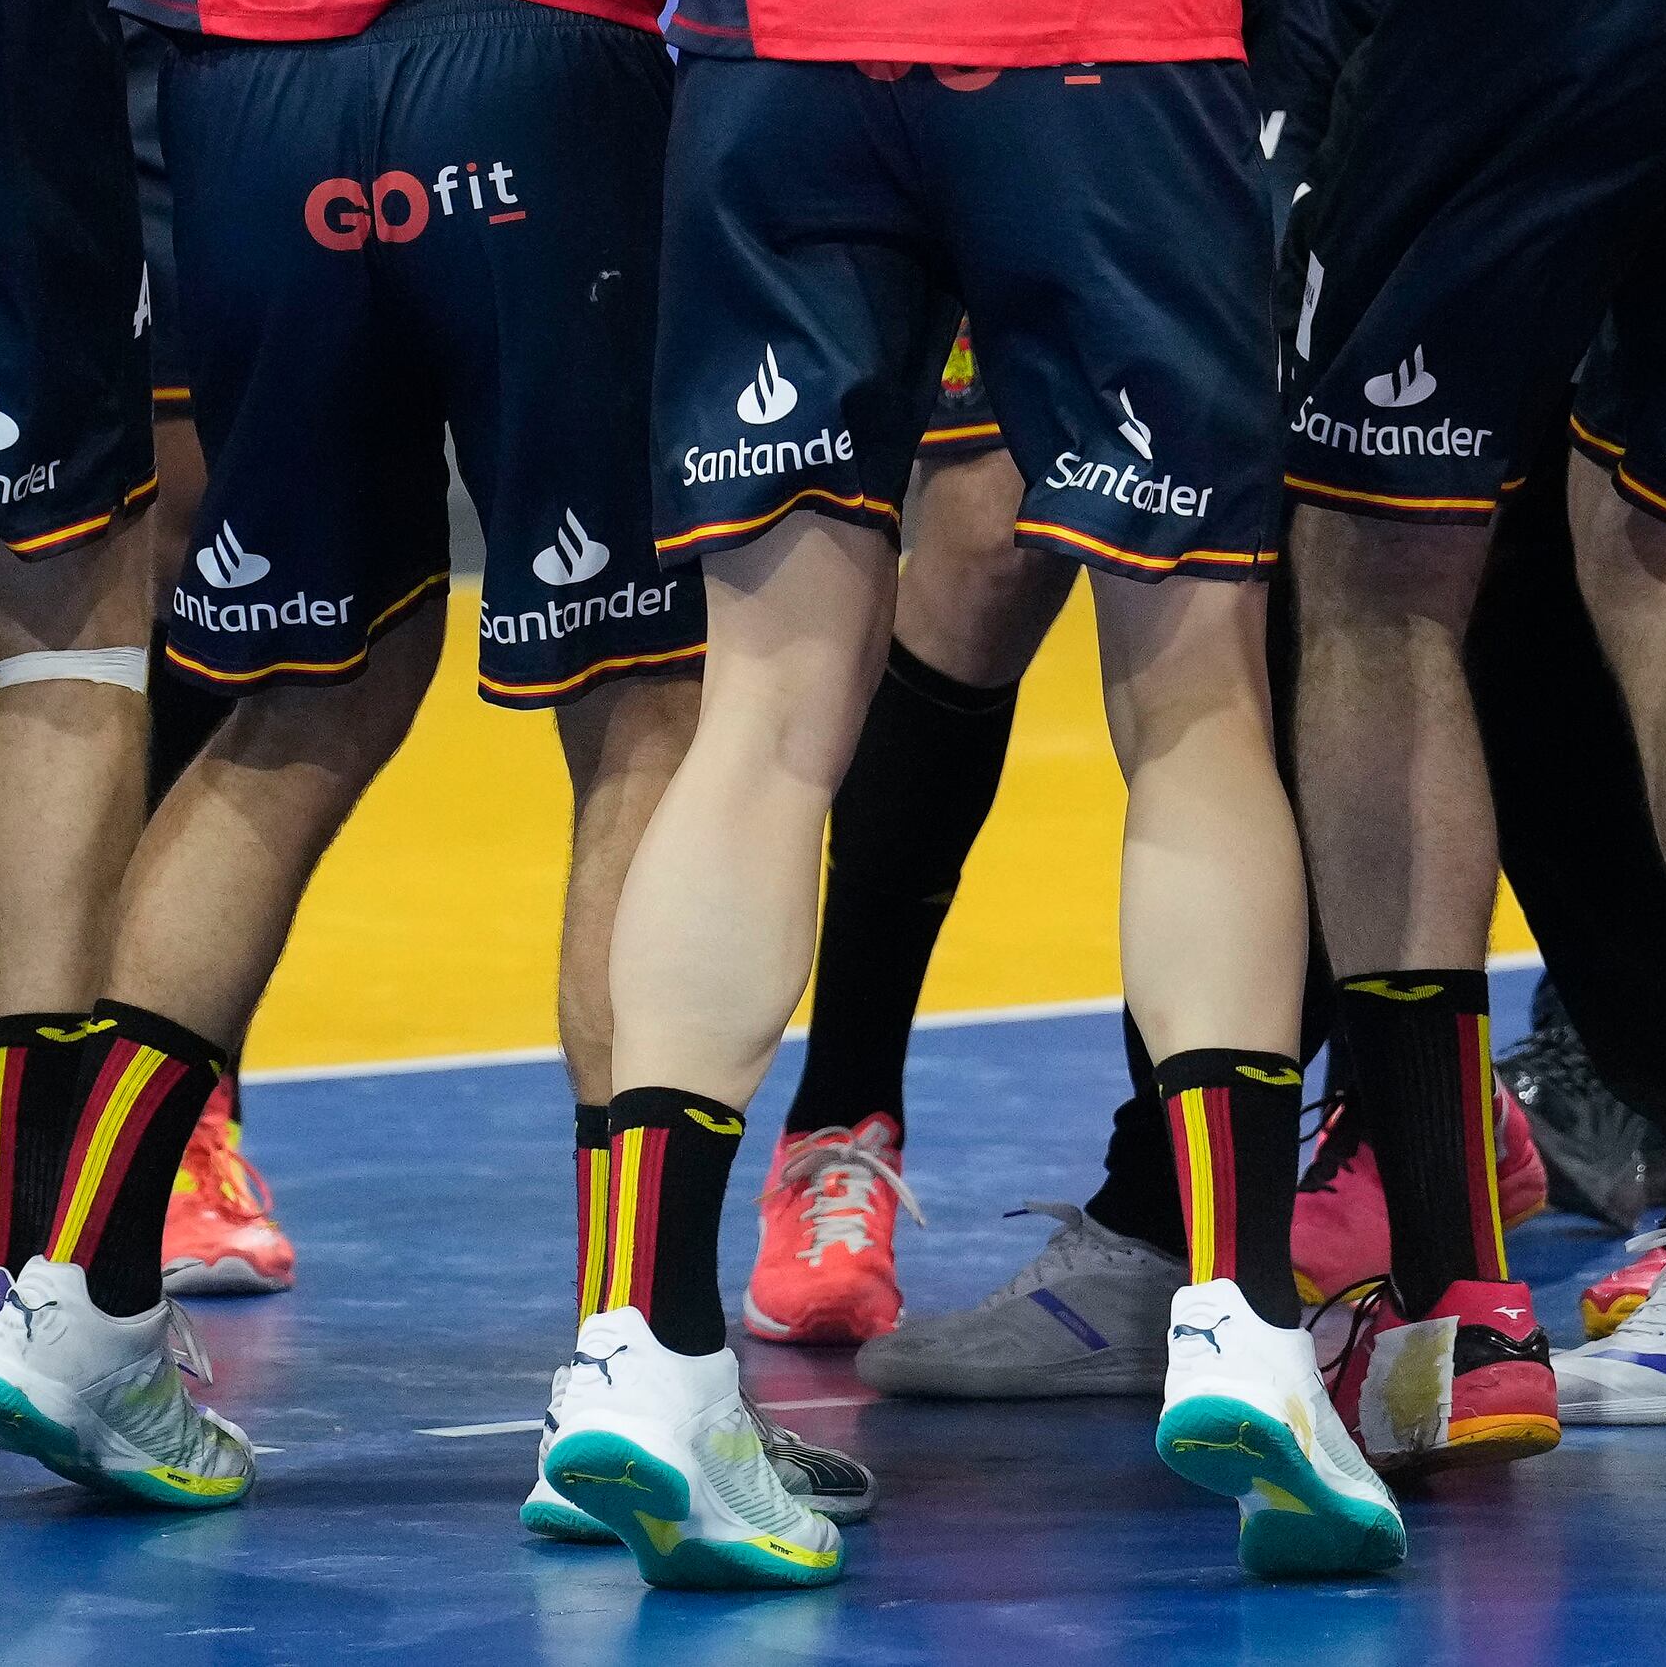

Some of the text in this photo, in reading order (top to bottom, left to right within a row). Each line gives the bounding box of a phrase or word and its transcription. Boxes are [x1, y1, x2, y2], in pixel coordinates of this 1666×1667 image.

[304, 161, 519, 251] GO fit
[683, 428, 854, 486] Santande
[1291, 396, 1493, 458] Santander
[173, 586, 354, 632] antander
